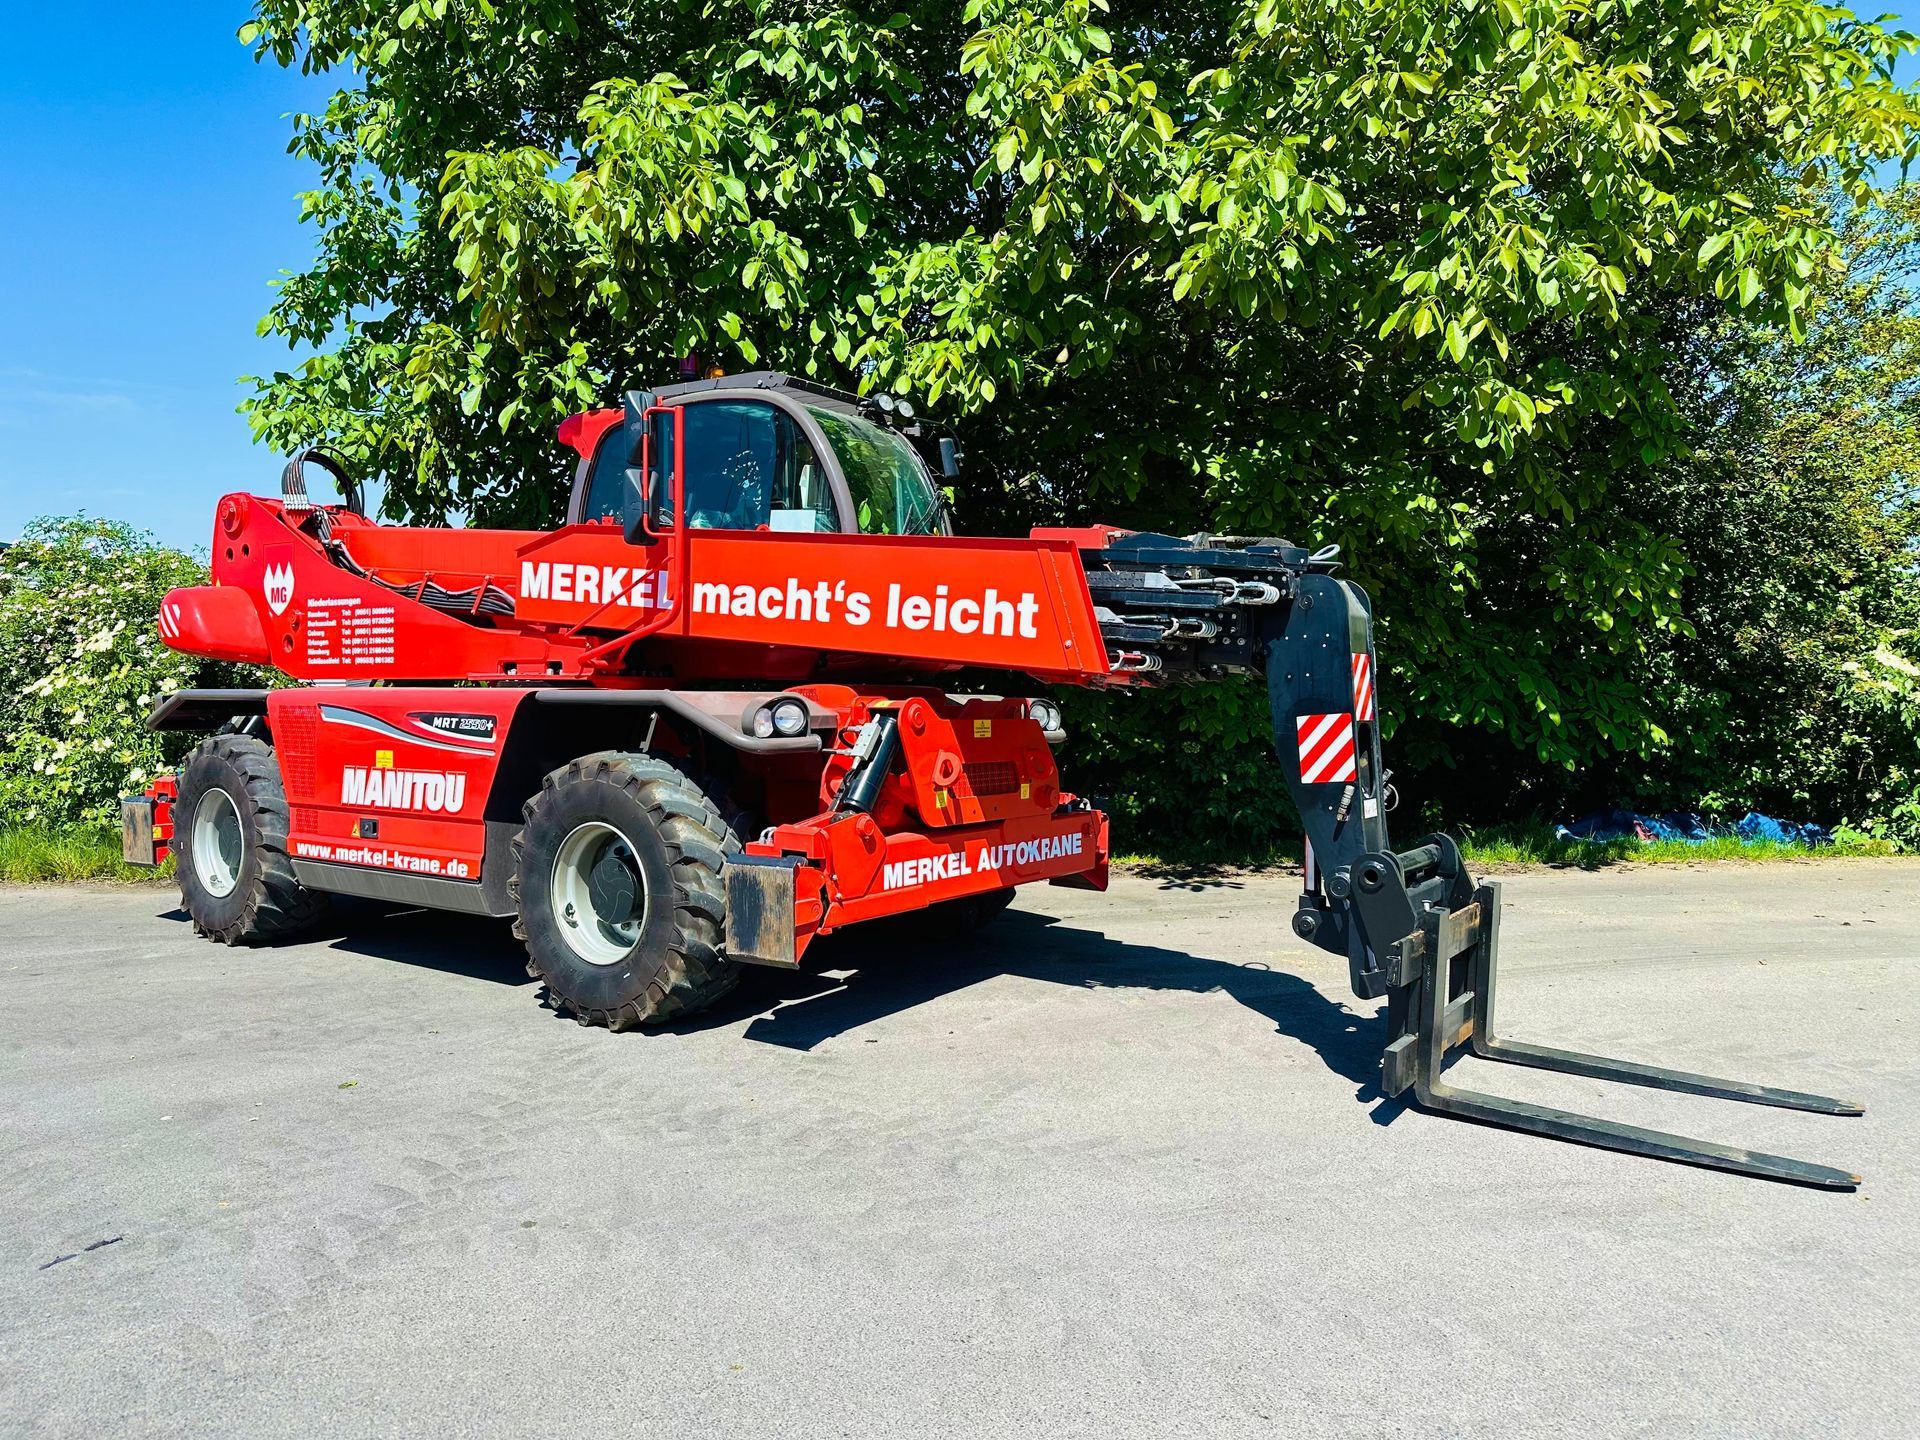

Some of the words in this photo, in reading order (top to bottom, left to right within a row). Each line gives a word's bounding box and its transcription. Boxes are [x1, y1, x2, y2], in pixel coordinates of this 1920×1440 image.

[271, 587, 287, 603] MG
[308, 598, 361, 607] Niederlassungen
[520, 561, 674, 611] MERKEL
[885, 583, 1039, 639] leicht
[433, 717, 459, 729] MRT
[341, 765, 467, 813] MANITOU
[296, 842, 469, 877] www.merkel-krane.de
[884, 851, 972, 890] MERKEL
[977, 833, 1082, 872] AUTOKRANE
